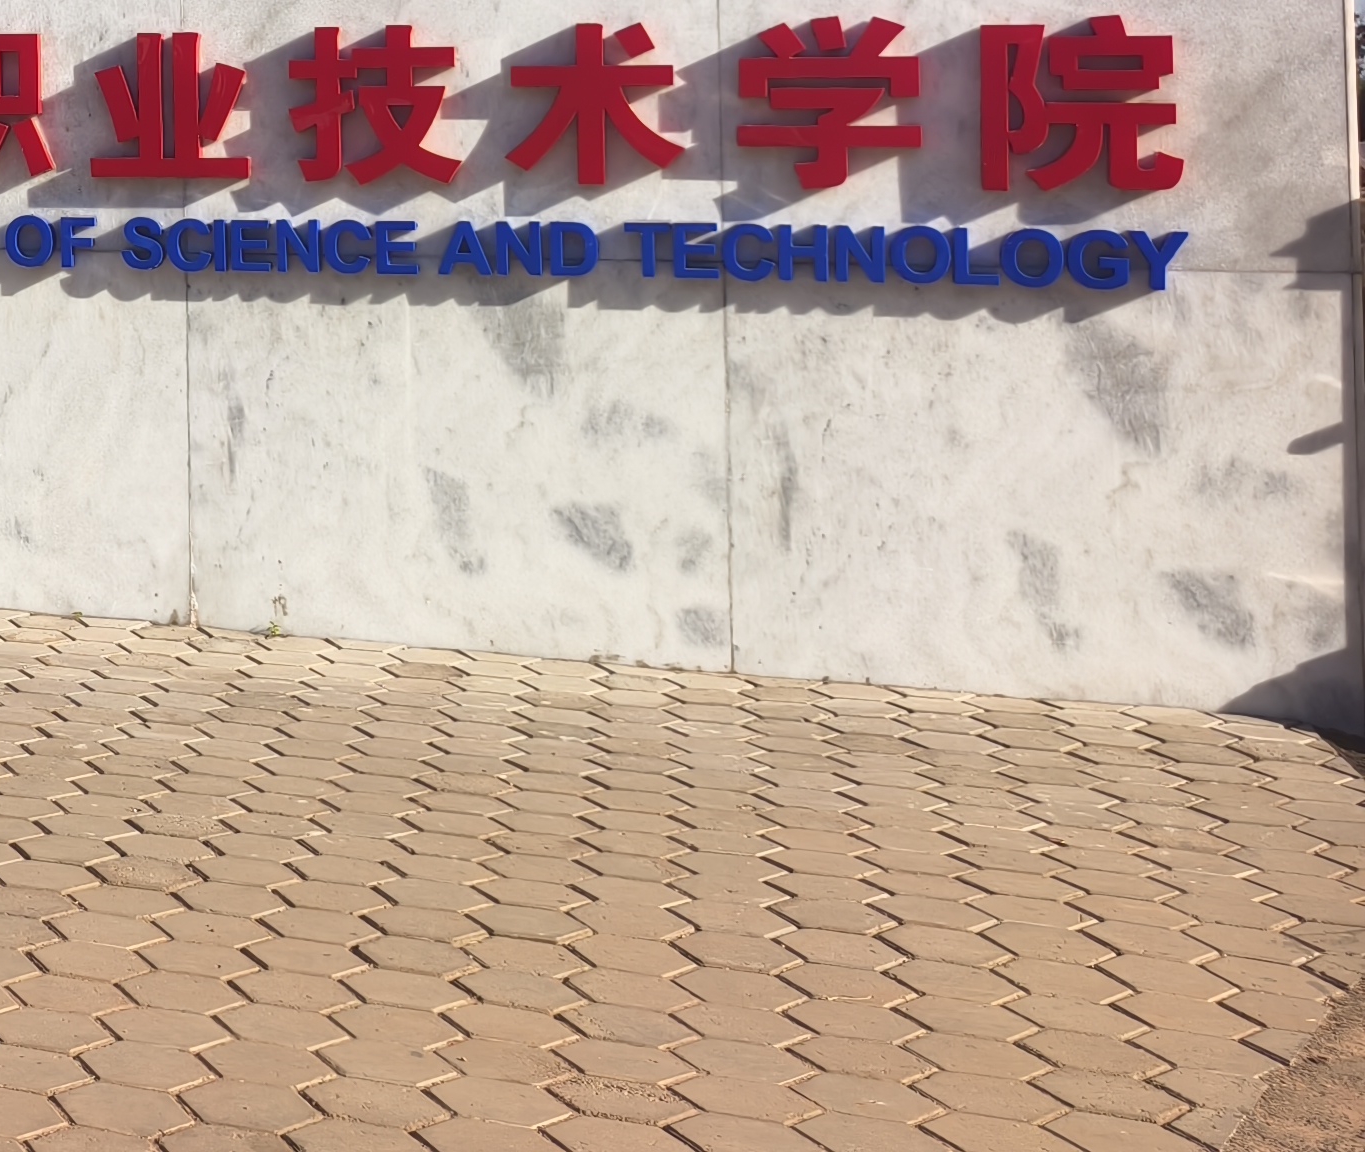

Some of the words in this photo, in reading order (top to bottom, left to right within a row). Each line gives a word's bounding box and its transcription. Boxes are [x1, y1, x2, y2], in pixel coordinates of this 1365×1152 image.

[5, 214, 98, 268] OF
[121, 216, 419, 276] SCIENCE
[438, 221, 600, 277] AND
[623, 221, 1189, 290] TECHNOLOGY
